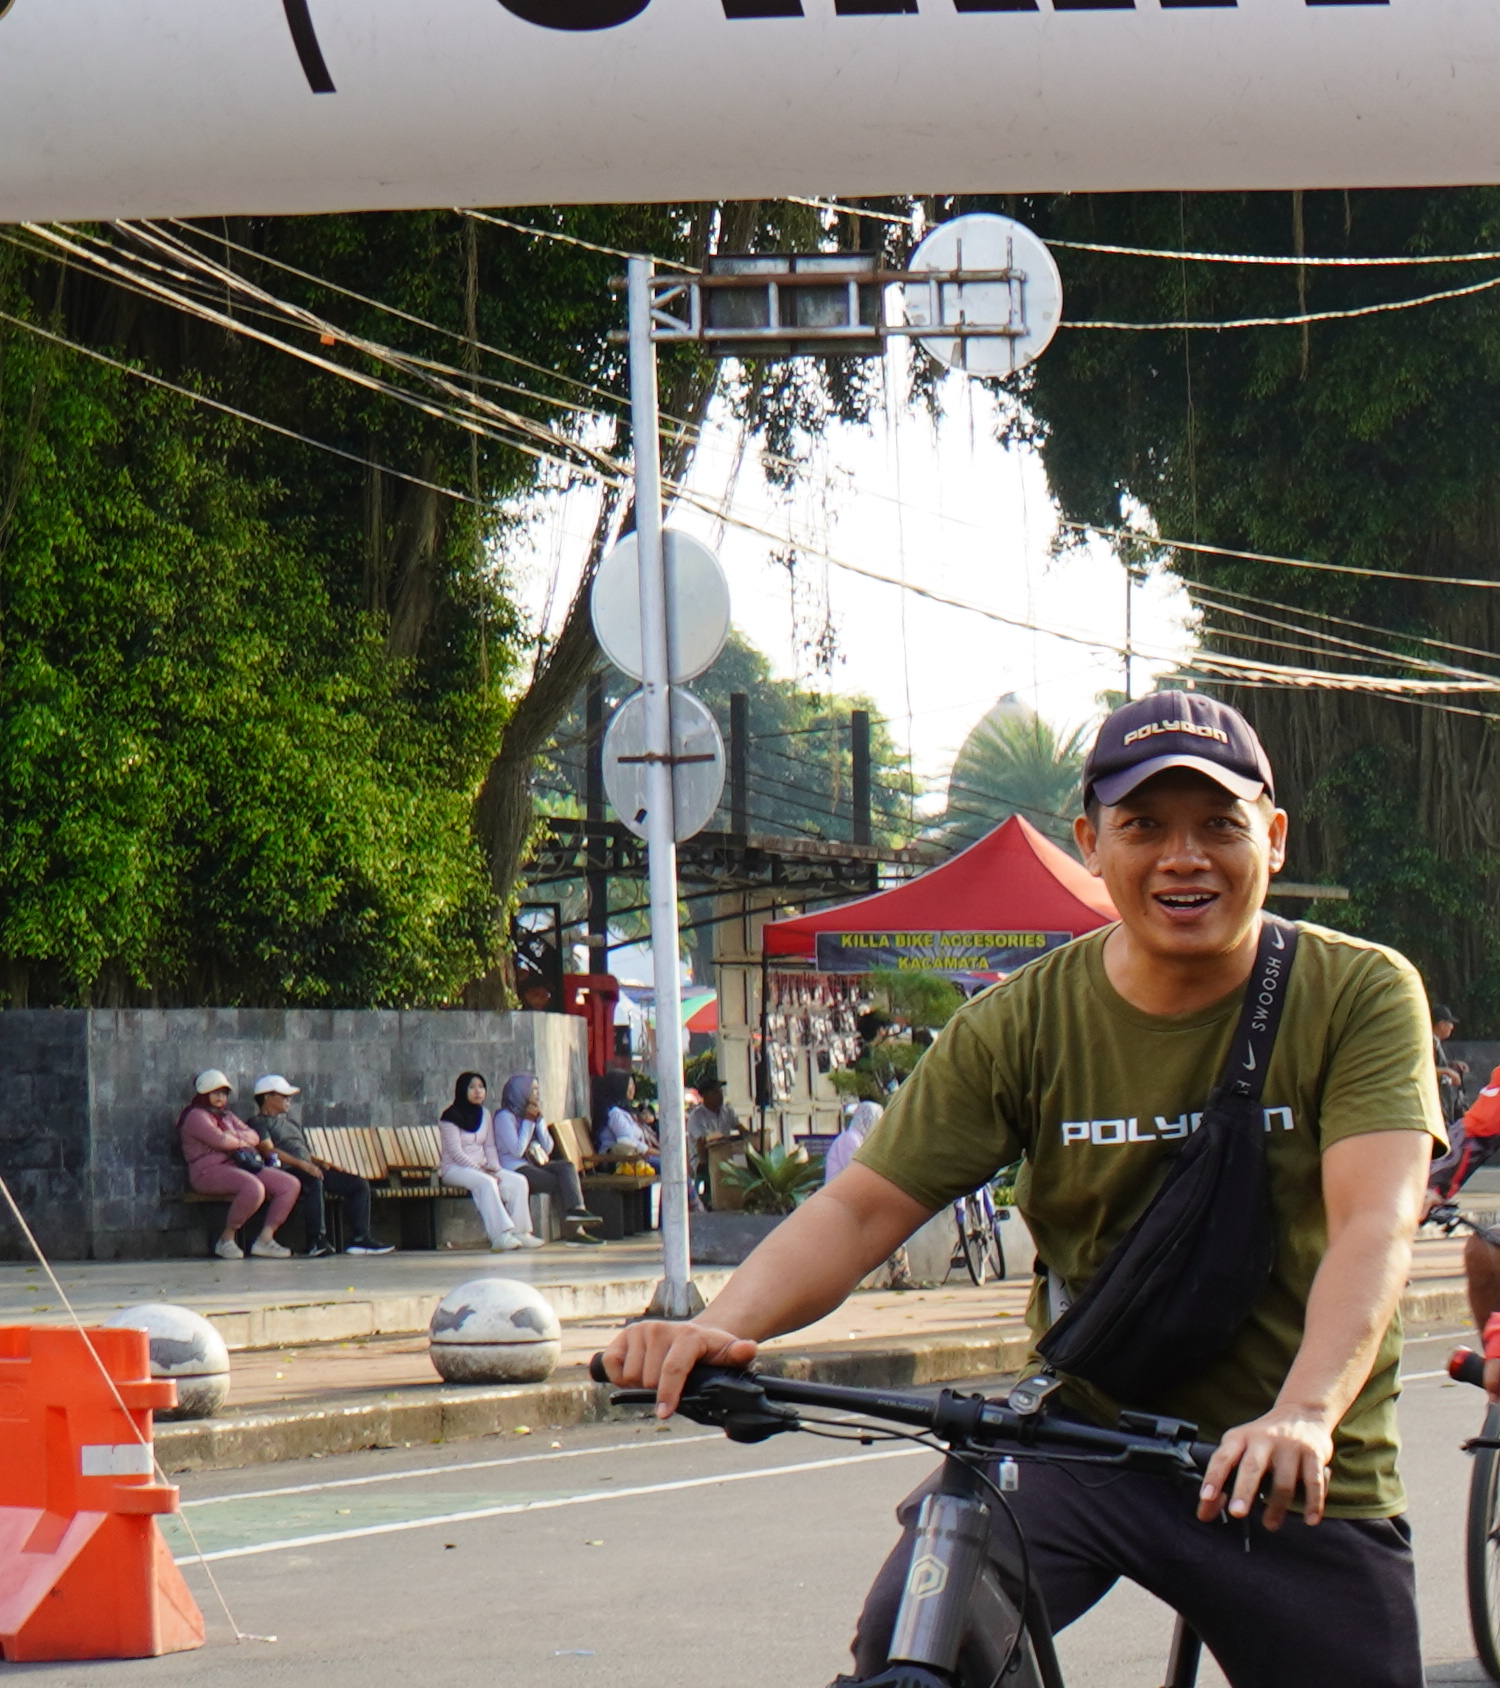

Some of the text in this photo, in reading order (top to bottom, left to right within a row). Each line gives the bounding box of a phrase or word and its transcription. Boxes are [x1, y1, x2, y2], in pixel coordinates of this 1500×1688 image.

[1123, 719, 1230, 746] POLYGON
[841, 933, 1046, 949] KILLA BIKE ACCESORIES
[898, 956, 990, 970] KACAMATA
[1252, 956, 1283, 1032] SWOOSH
[1061, 1106, 1295, 1147] POLYN
